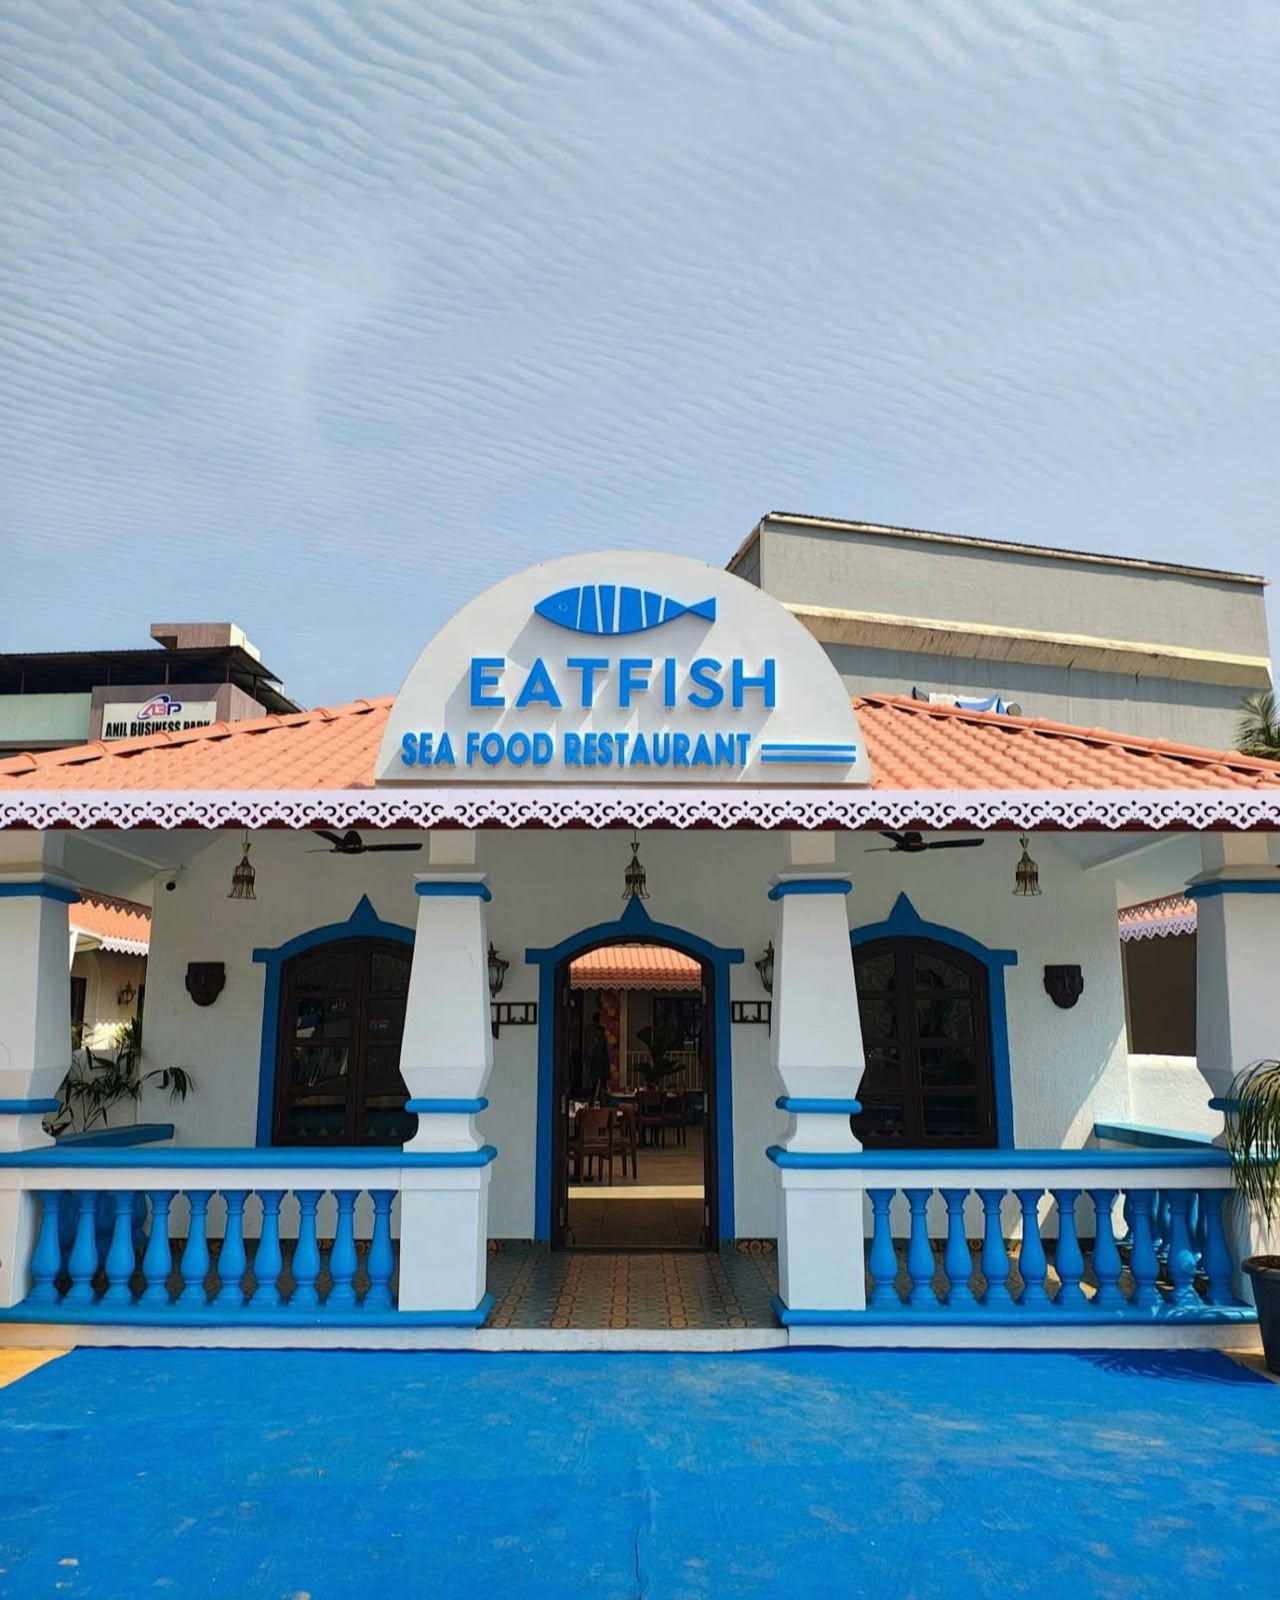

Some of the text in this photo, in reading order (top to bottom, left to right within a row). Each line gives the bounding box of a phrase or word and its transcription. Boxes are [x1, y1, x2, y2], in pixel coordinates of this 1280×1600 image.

[470, 657, 776, 709] EATFISH
[105, 721, 128, 737] ANIL
[130, 720, 181, 737] BUSINESS
[401, 732, 752, 766] SEA FOOD RESTAURANT
